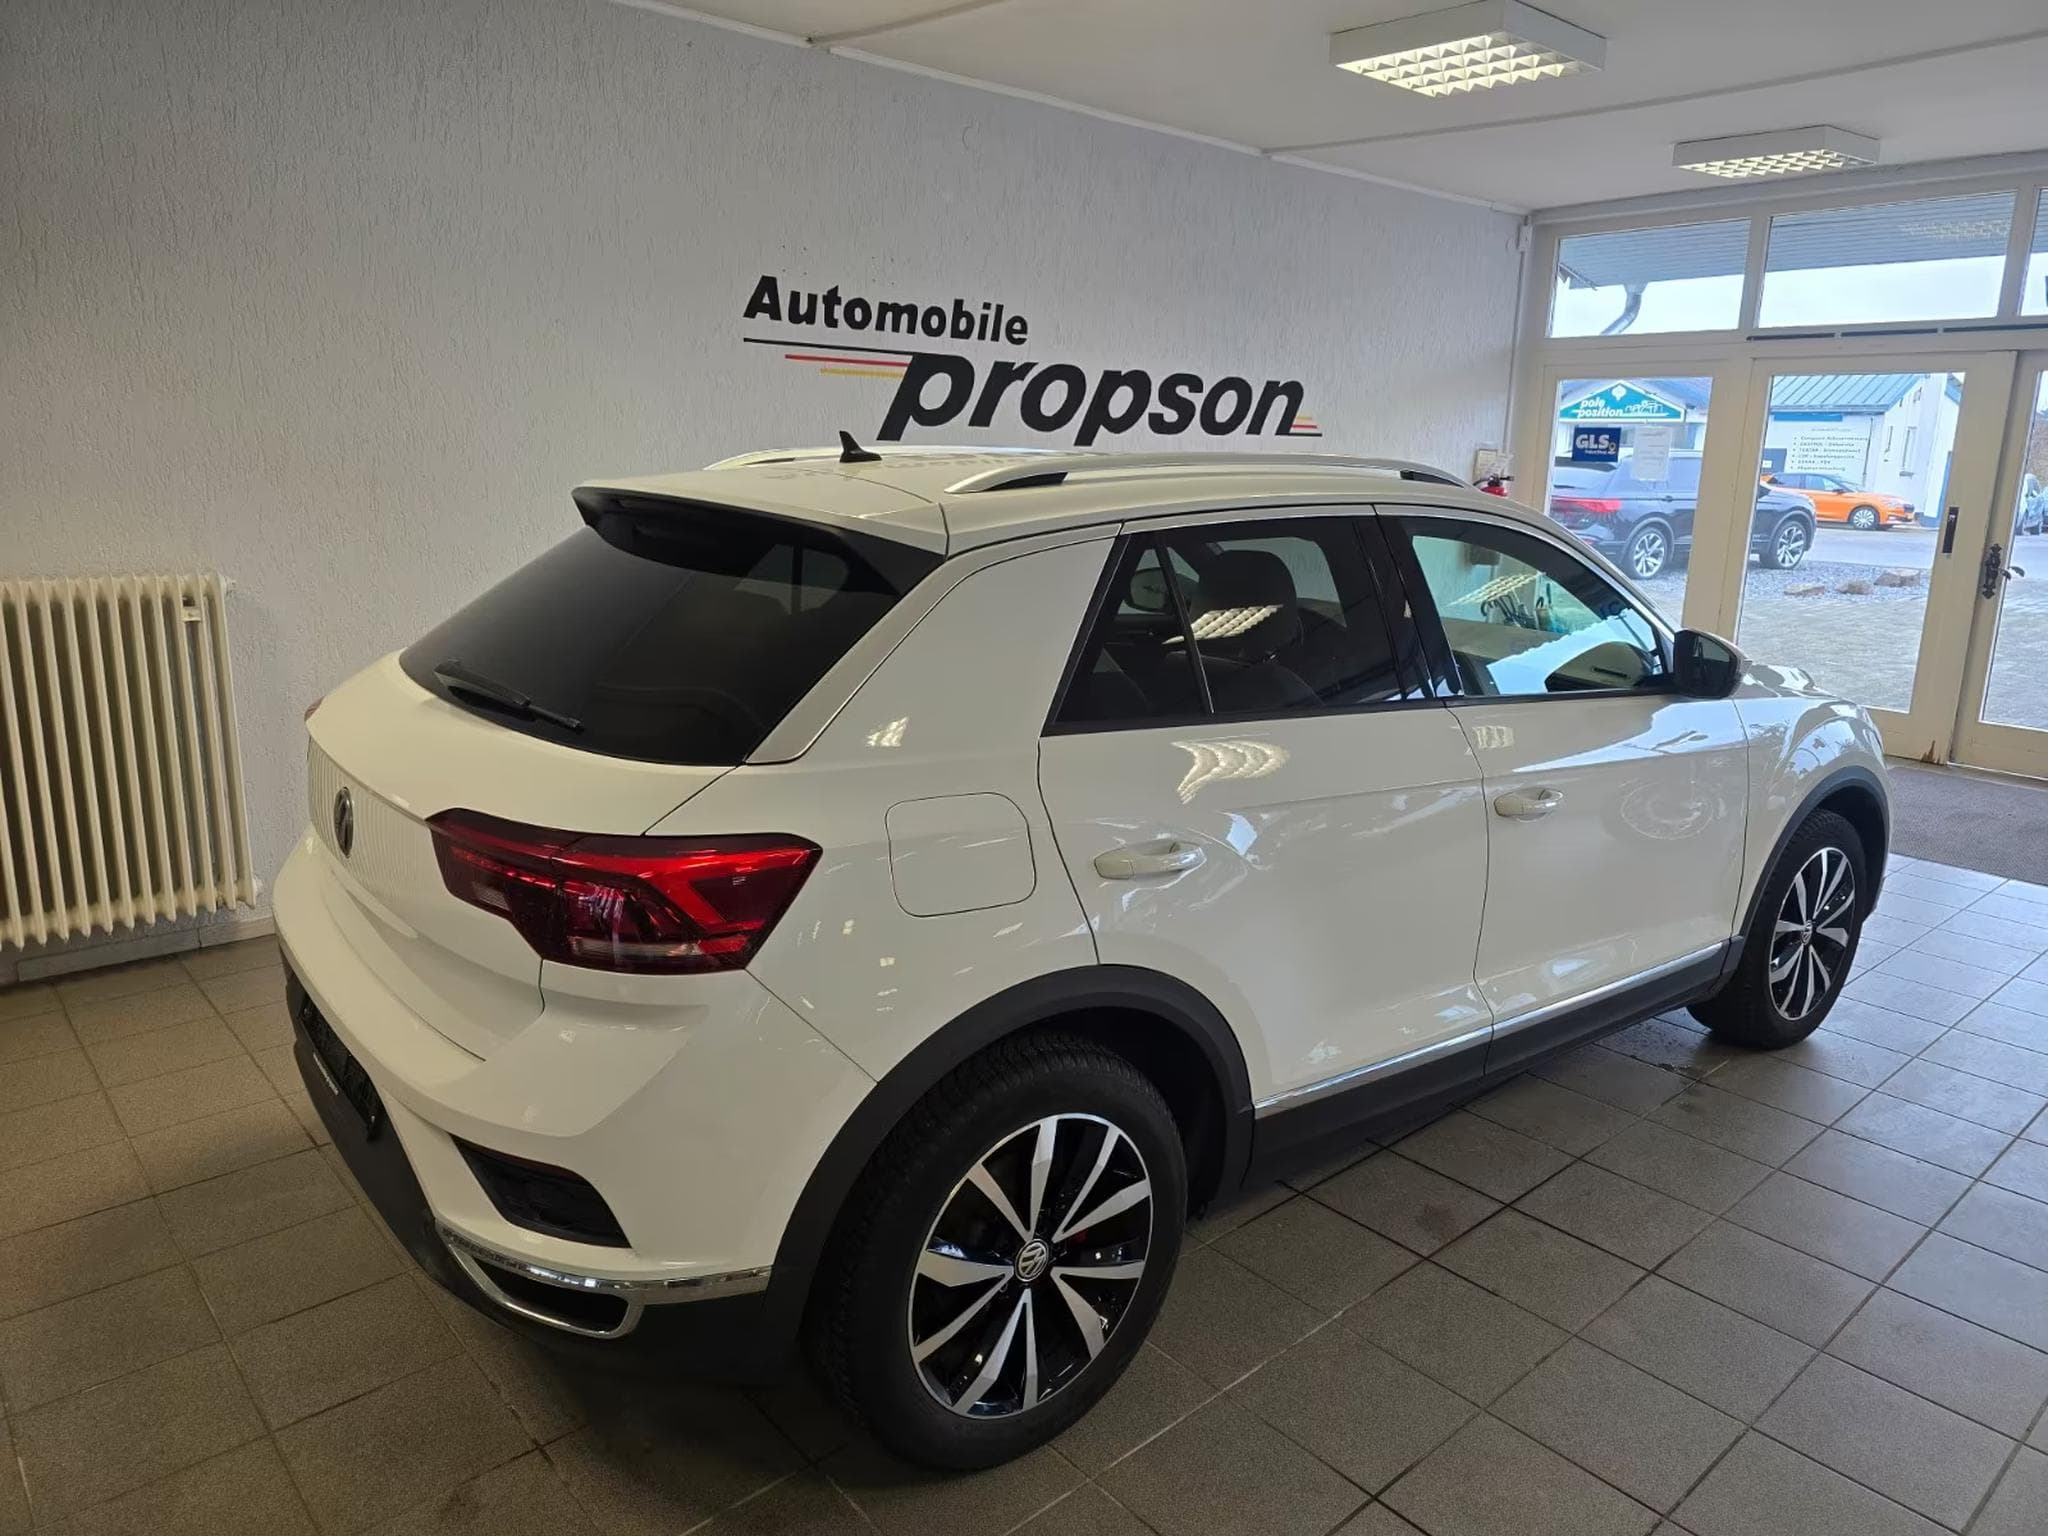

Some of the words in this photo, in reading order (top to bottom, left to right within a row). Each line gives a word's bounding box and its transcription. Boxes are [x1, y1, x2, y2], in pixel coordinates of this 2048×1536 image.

[743, 275, 1029, 346] Automobile
[876, 352, 1305, 447] propson
[1577, 405, 1624, 418] position
[1575, 433, 1610, 449] GLS
